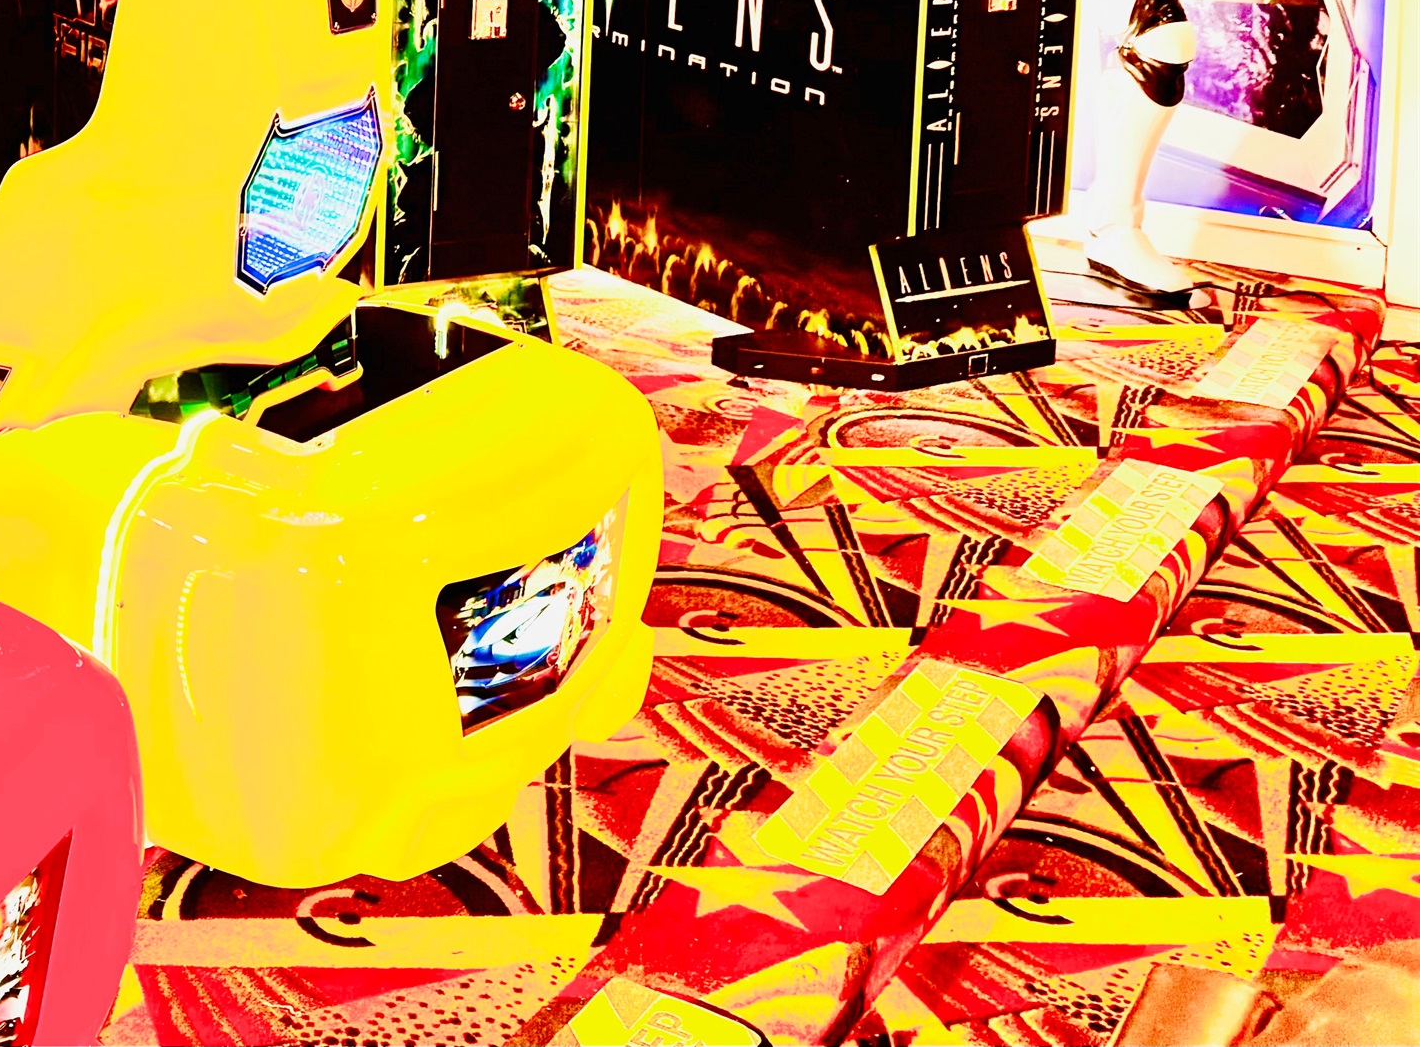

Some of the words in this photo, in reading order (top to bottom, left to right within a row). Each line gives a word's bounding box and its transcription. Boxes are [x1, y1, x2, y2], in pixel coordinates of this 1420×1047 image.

[899, 252, 1012, 294] ALIENS
[1066, 537, 1133, 585] WATCH
[1110, 500, 1164, 537] YOUR
[1140, 472, 1187, 501] STEP
[801, 782, 905, 866] WATCH
[874, 727, 954, 784] YOUR
[928, 679, 991, 727] STEP
